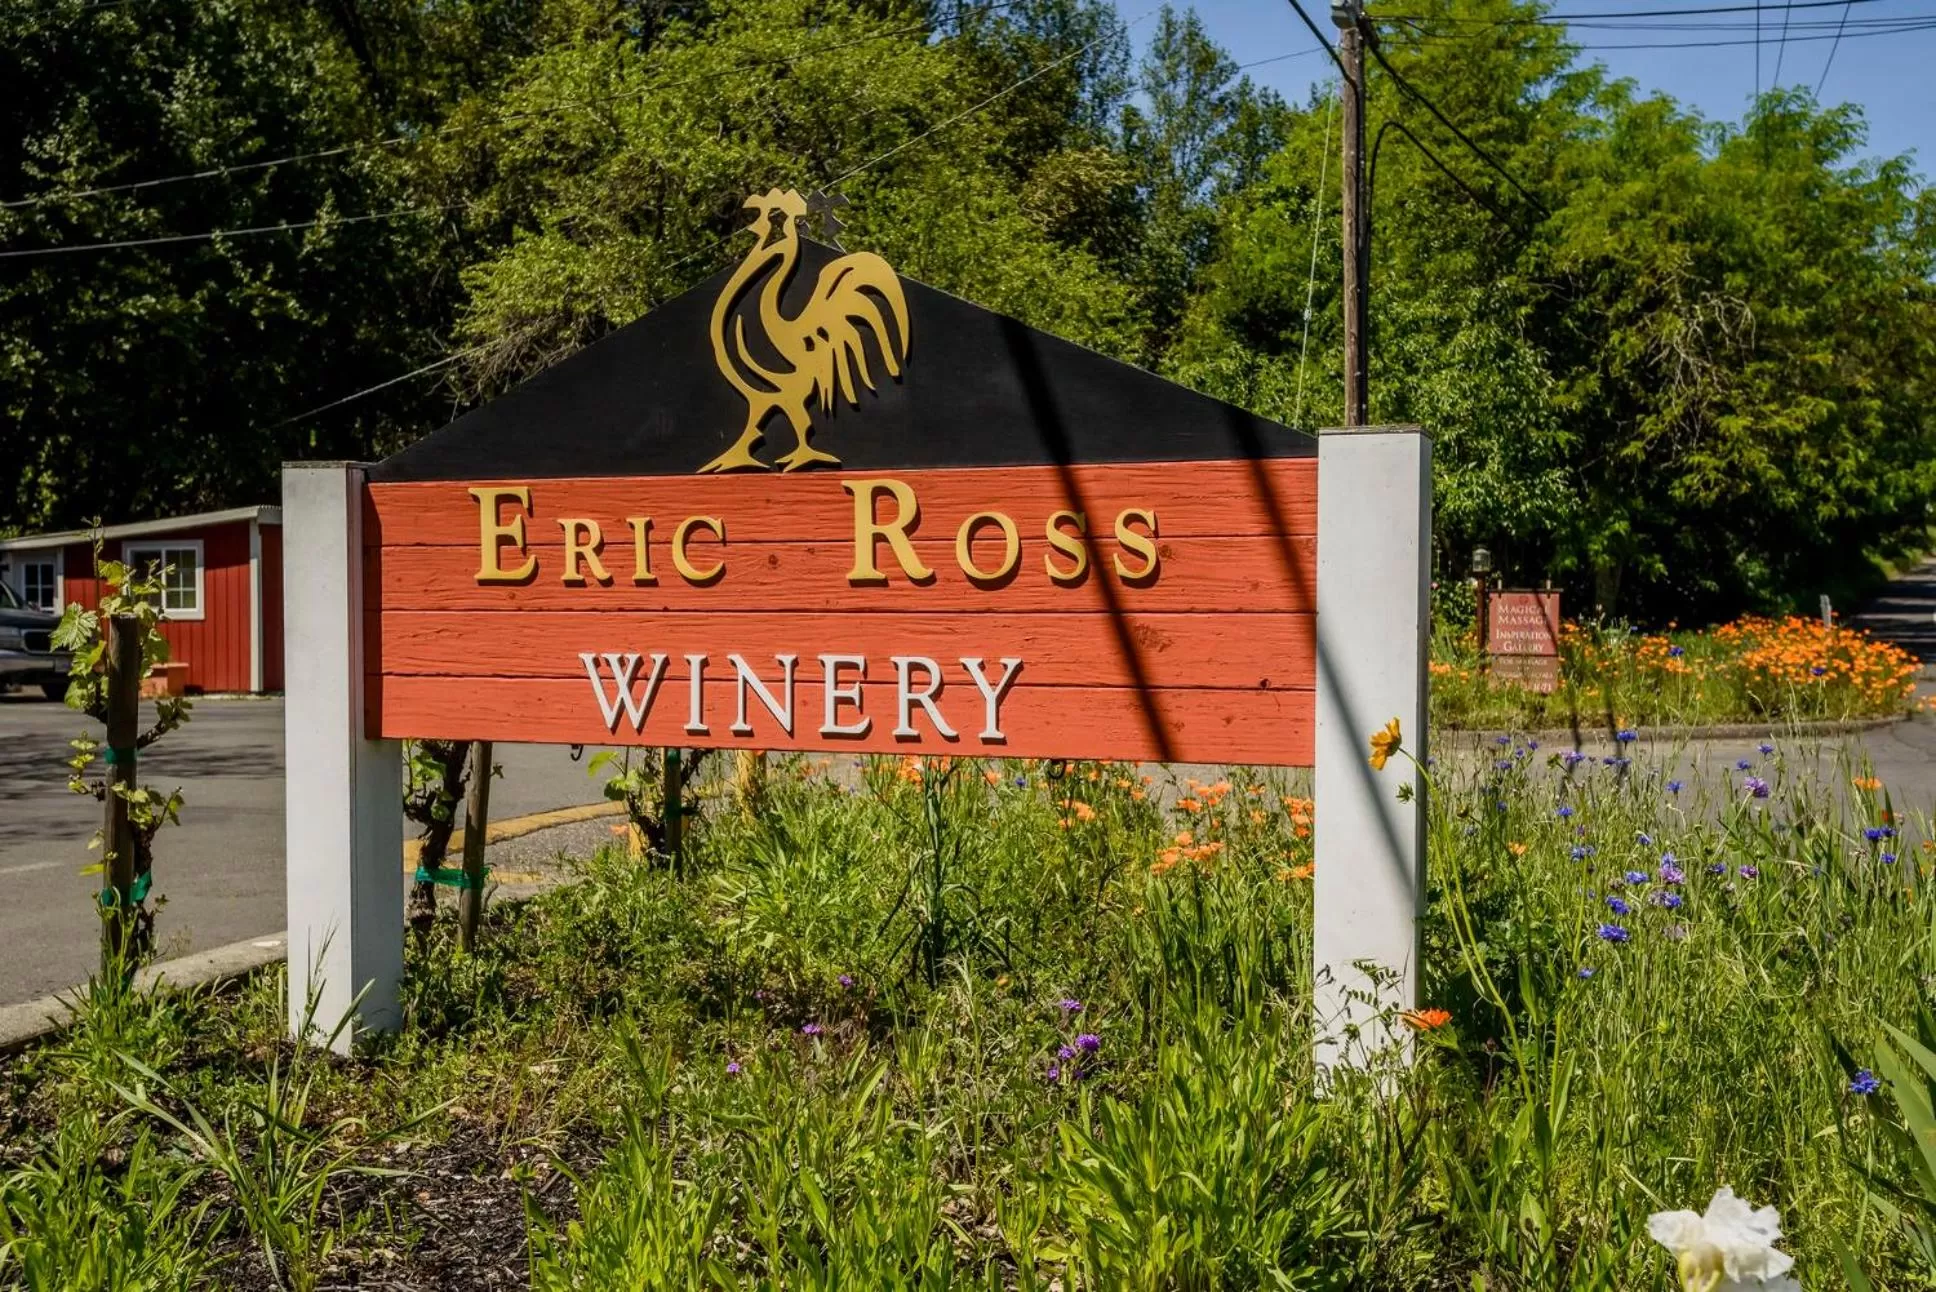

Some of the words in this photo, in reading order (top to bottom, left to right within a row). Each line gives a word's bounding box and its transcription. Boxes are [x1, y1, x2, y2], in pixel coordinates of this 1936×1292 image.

[468, 486, 725, 586] ERIC
[840, 478, 1161, 588] ROSS
[578, 652, 1023, 743] WINERY
